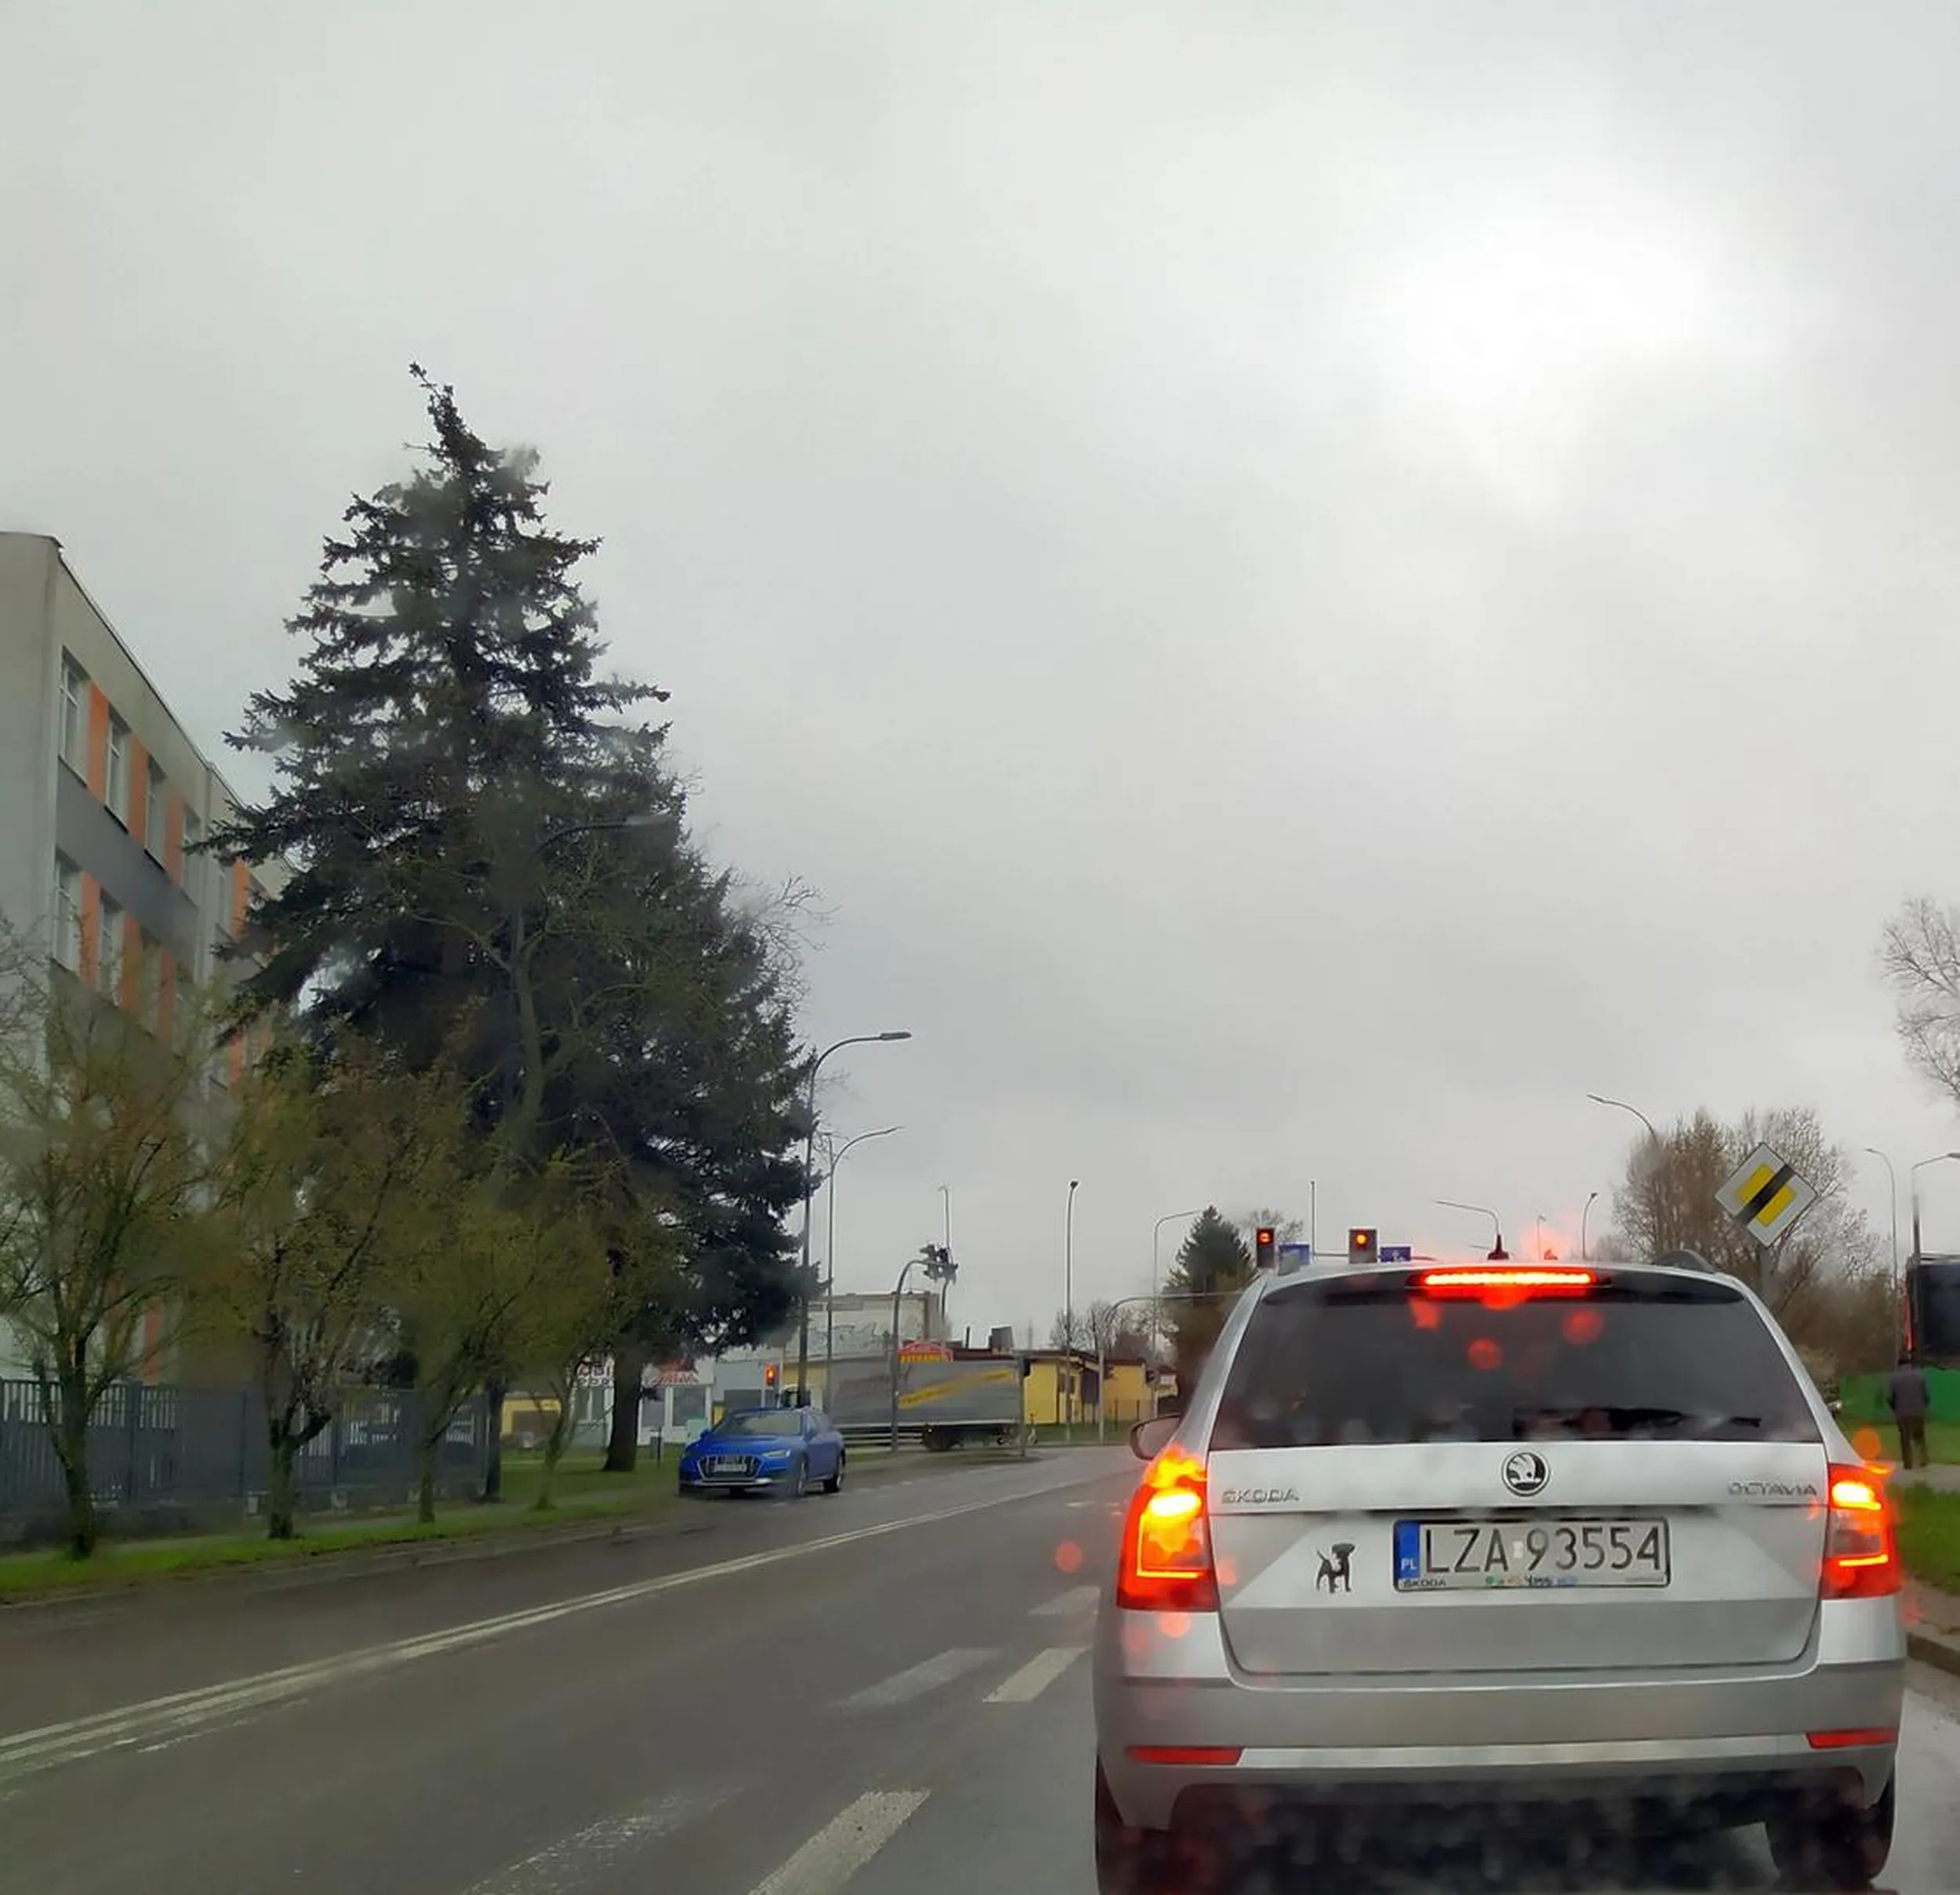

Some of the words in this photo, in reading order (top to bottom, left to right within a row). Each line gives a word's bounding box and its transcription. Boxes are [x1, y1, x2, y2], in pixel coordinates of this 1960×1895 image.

[1728, 1480, 1817, 1495] OCTAVIA
[1425, 1529, 1508, 1573] LZA
[1526, 1526, 1661, 1571] 93554
[1401, 1558, 1417, 1570] PL
